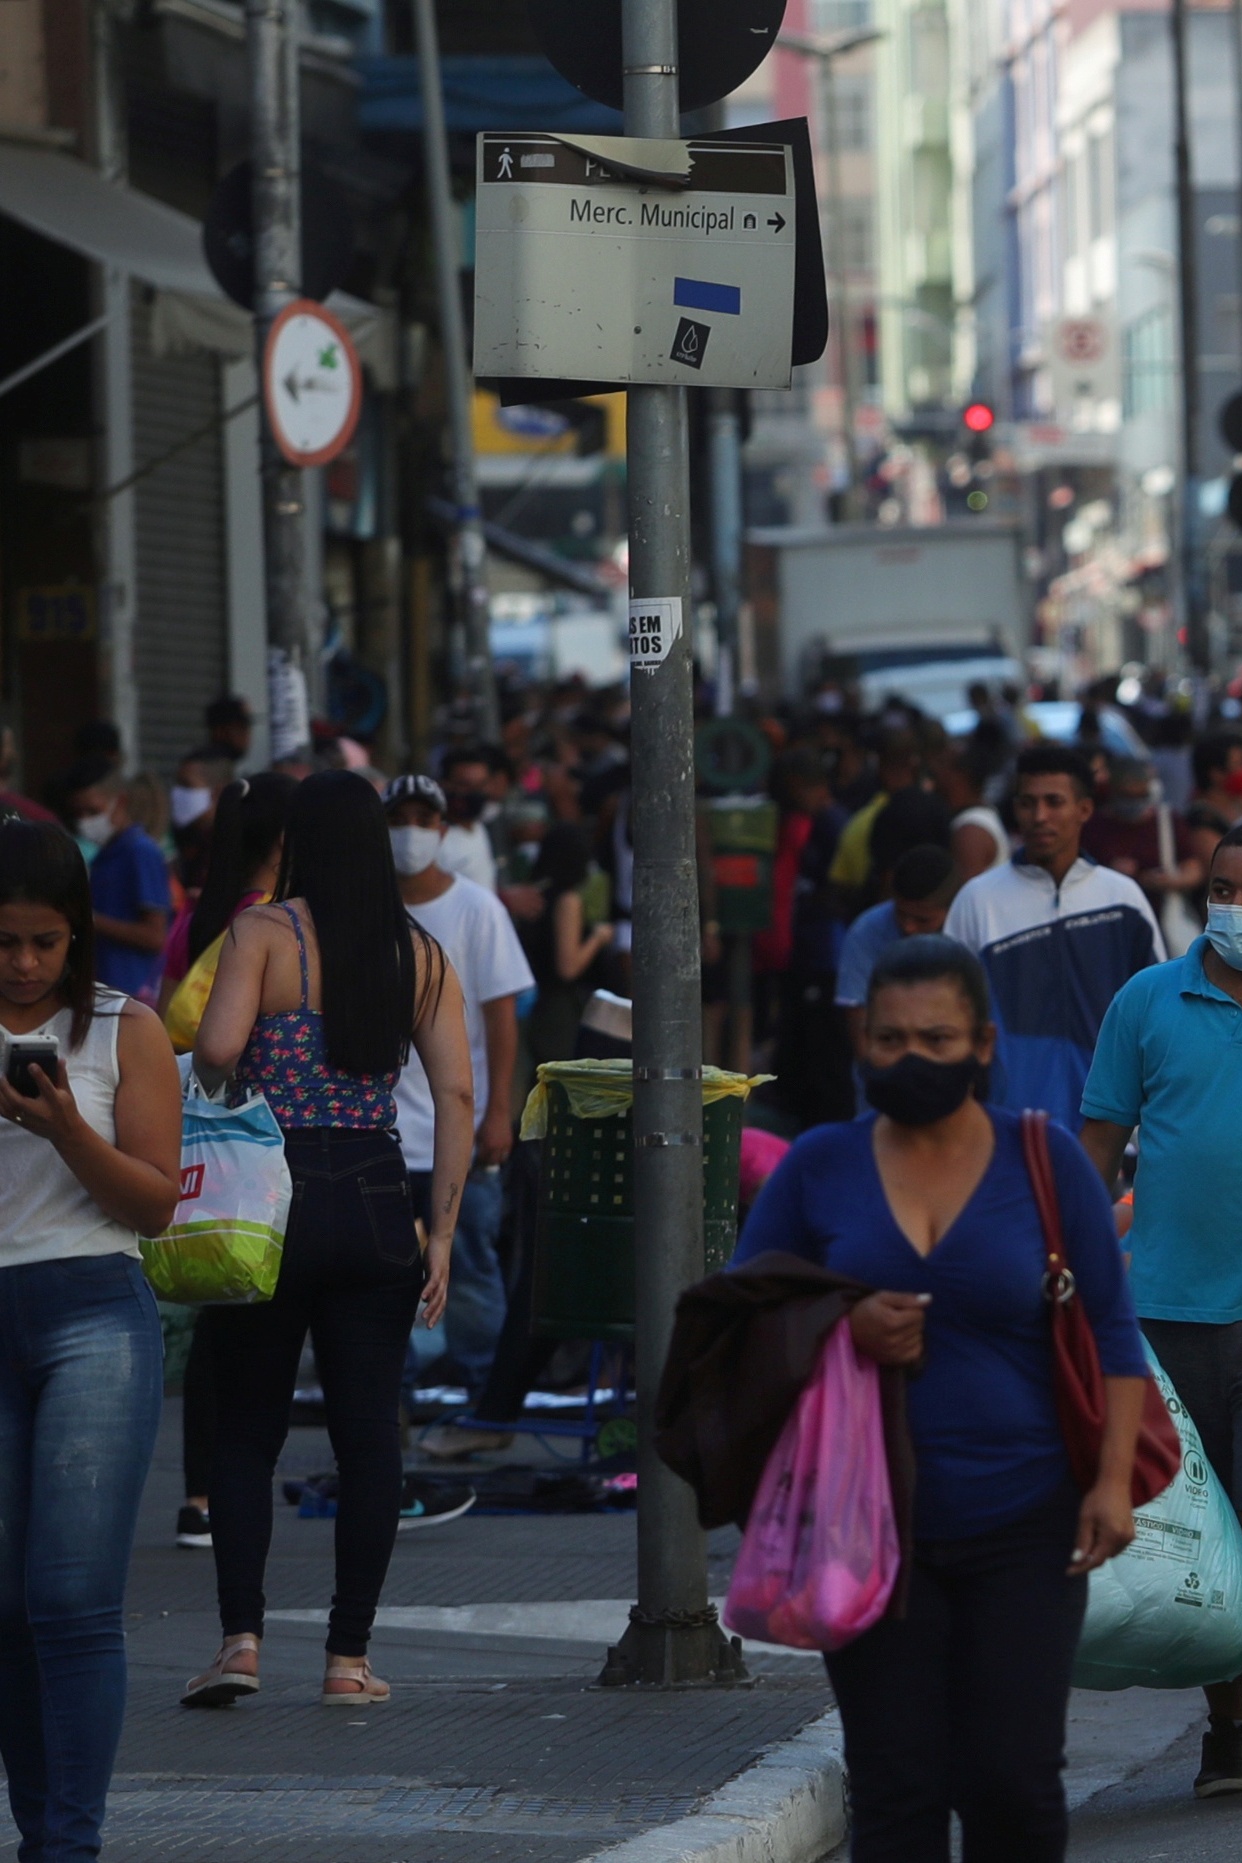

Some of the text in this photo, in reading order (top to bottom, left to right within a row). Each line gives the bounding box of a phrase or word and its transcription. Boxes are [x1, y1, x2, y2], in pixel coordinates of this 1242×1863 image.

[570, 199, 735, 235] Merc. Municipal
[639, 615, 662, 633] EM
